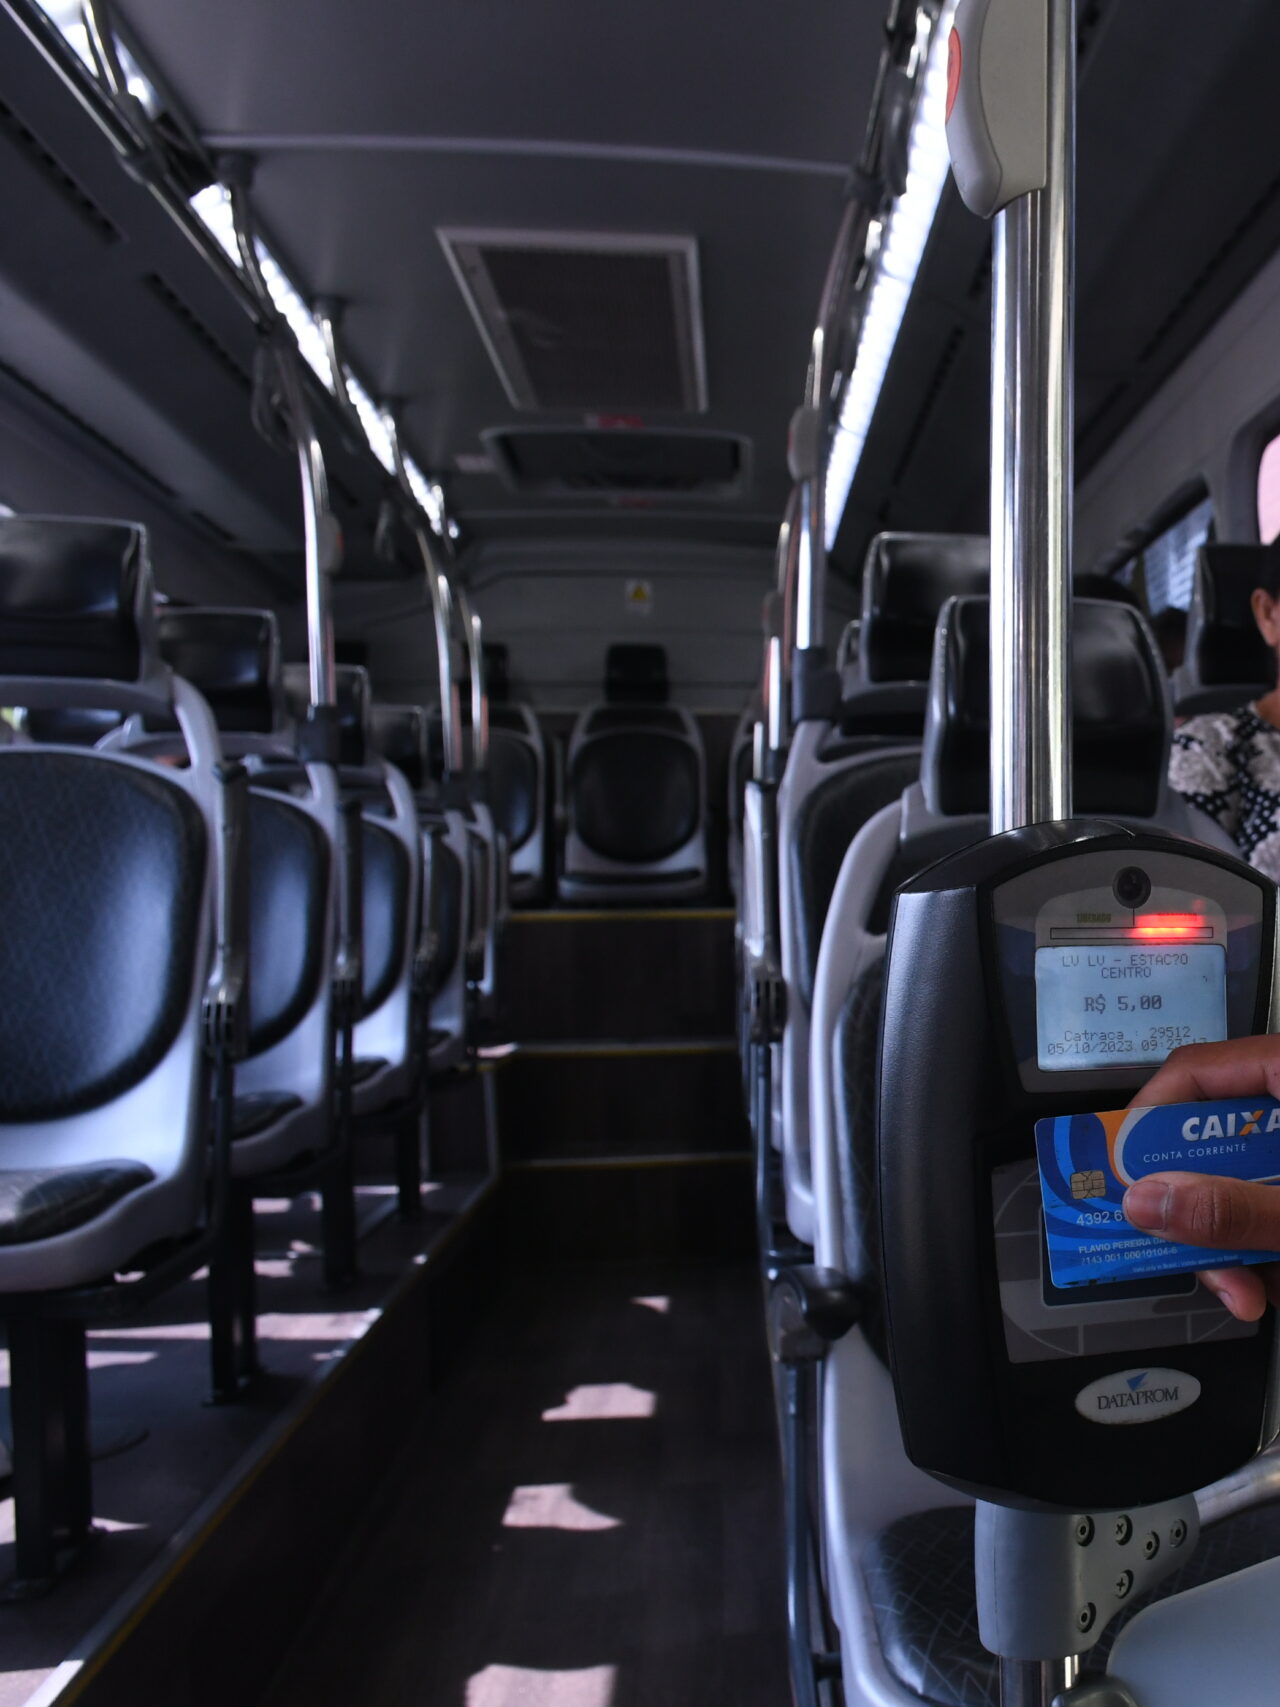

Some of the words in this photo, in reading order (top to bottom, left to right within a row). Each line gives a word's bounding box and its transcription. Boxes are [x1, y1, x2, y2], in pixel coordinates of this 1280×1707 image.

[1130, 953, 1189, 966] ESTAC?O
[1101, 967, 1151, 979] CENTRO
[1083, 994, 1106, 1014] R$
[1117, 995, 1162, 1012] 5,00
[1064, 1029, 1125, 1042] Catraca
[1149, 1026, 1191, 1039] 29512
[1047, 1039, 1133, 1055] 05/10/2023
[1143, 1150, 1183, 1164] CONTA
[1187, 1143, 1247, 1158] CORRENTE
[1076, 1211, 1110, 1227] 4392
[1078, 1243, 1111, 1254] FLAVIO
[1112, 1238, 1151, 1249] PEREIRA
[1096, 1386, 1180, 1410] DATAPROM
